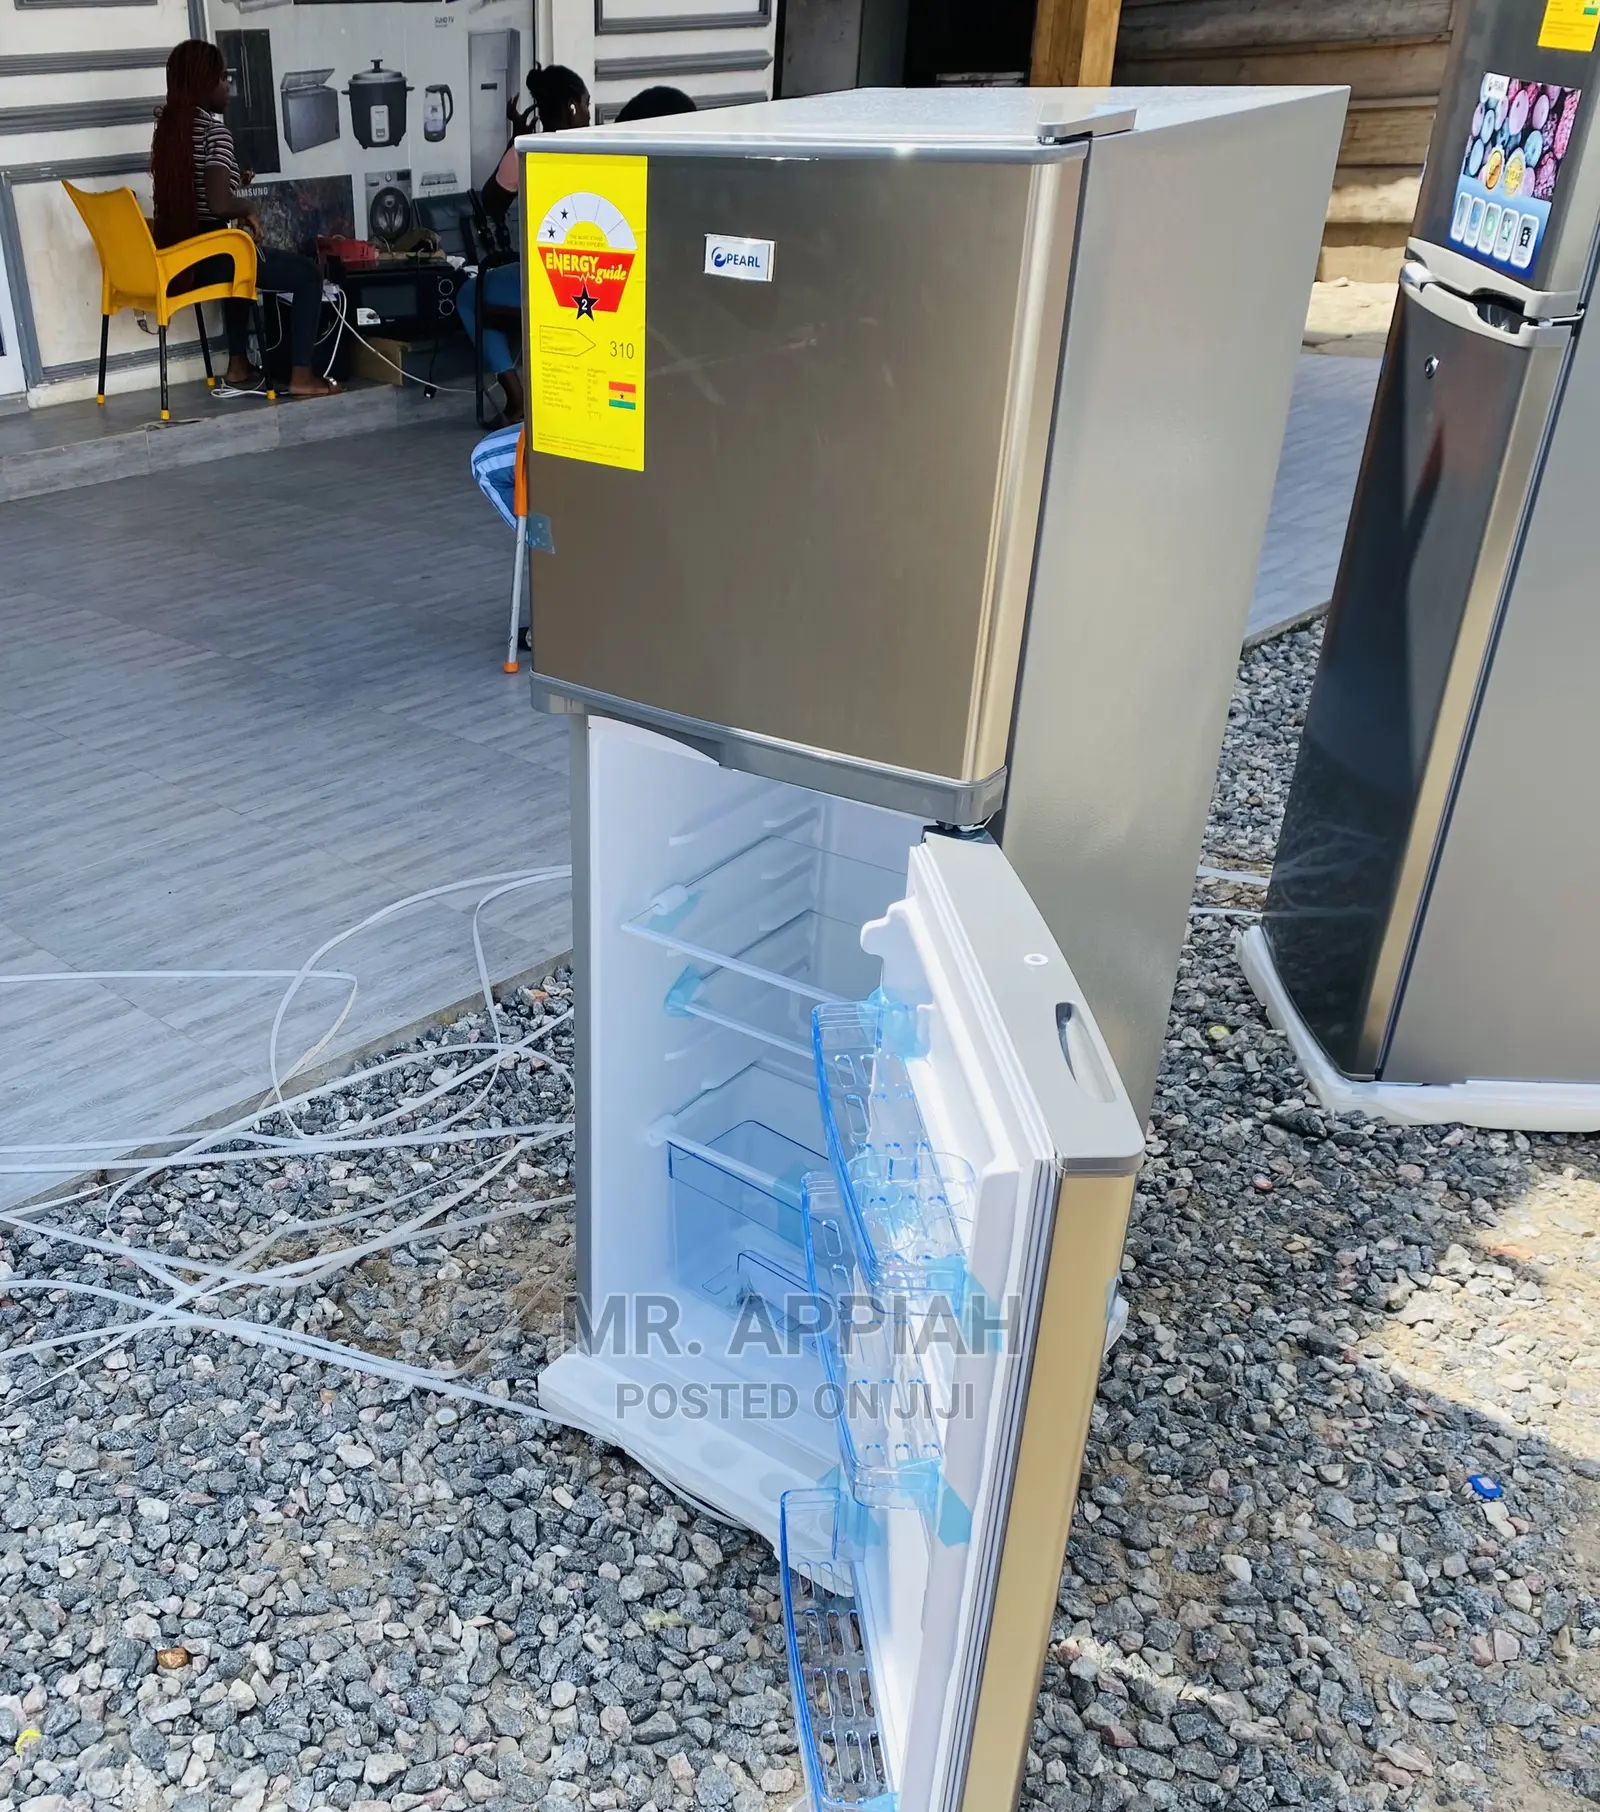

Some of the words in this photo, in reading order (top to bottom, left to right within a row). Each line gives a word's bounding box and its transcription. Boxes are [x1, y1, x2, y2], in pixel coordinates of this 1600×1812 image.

[545, 249, 600, 277] ENERGY
[726, 252, 761, 268] PEARL
[594, 263, 628, 284] guide
[581, 298, 588, 311] 2
[609, 340, 635, 360] 310
